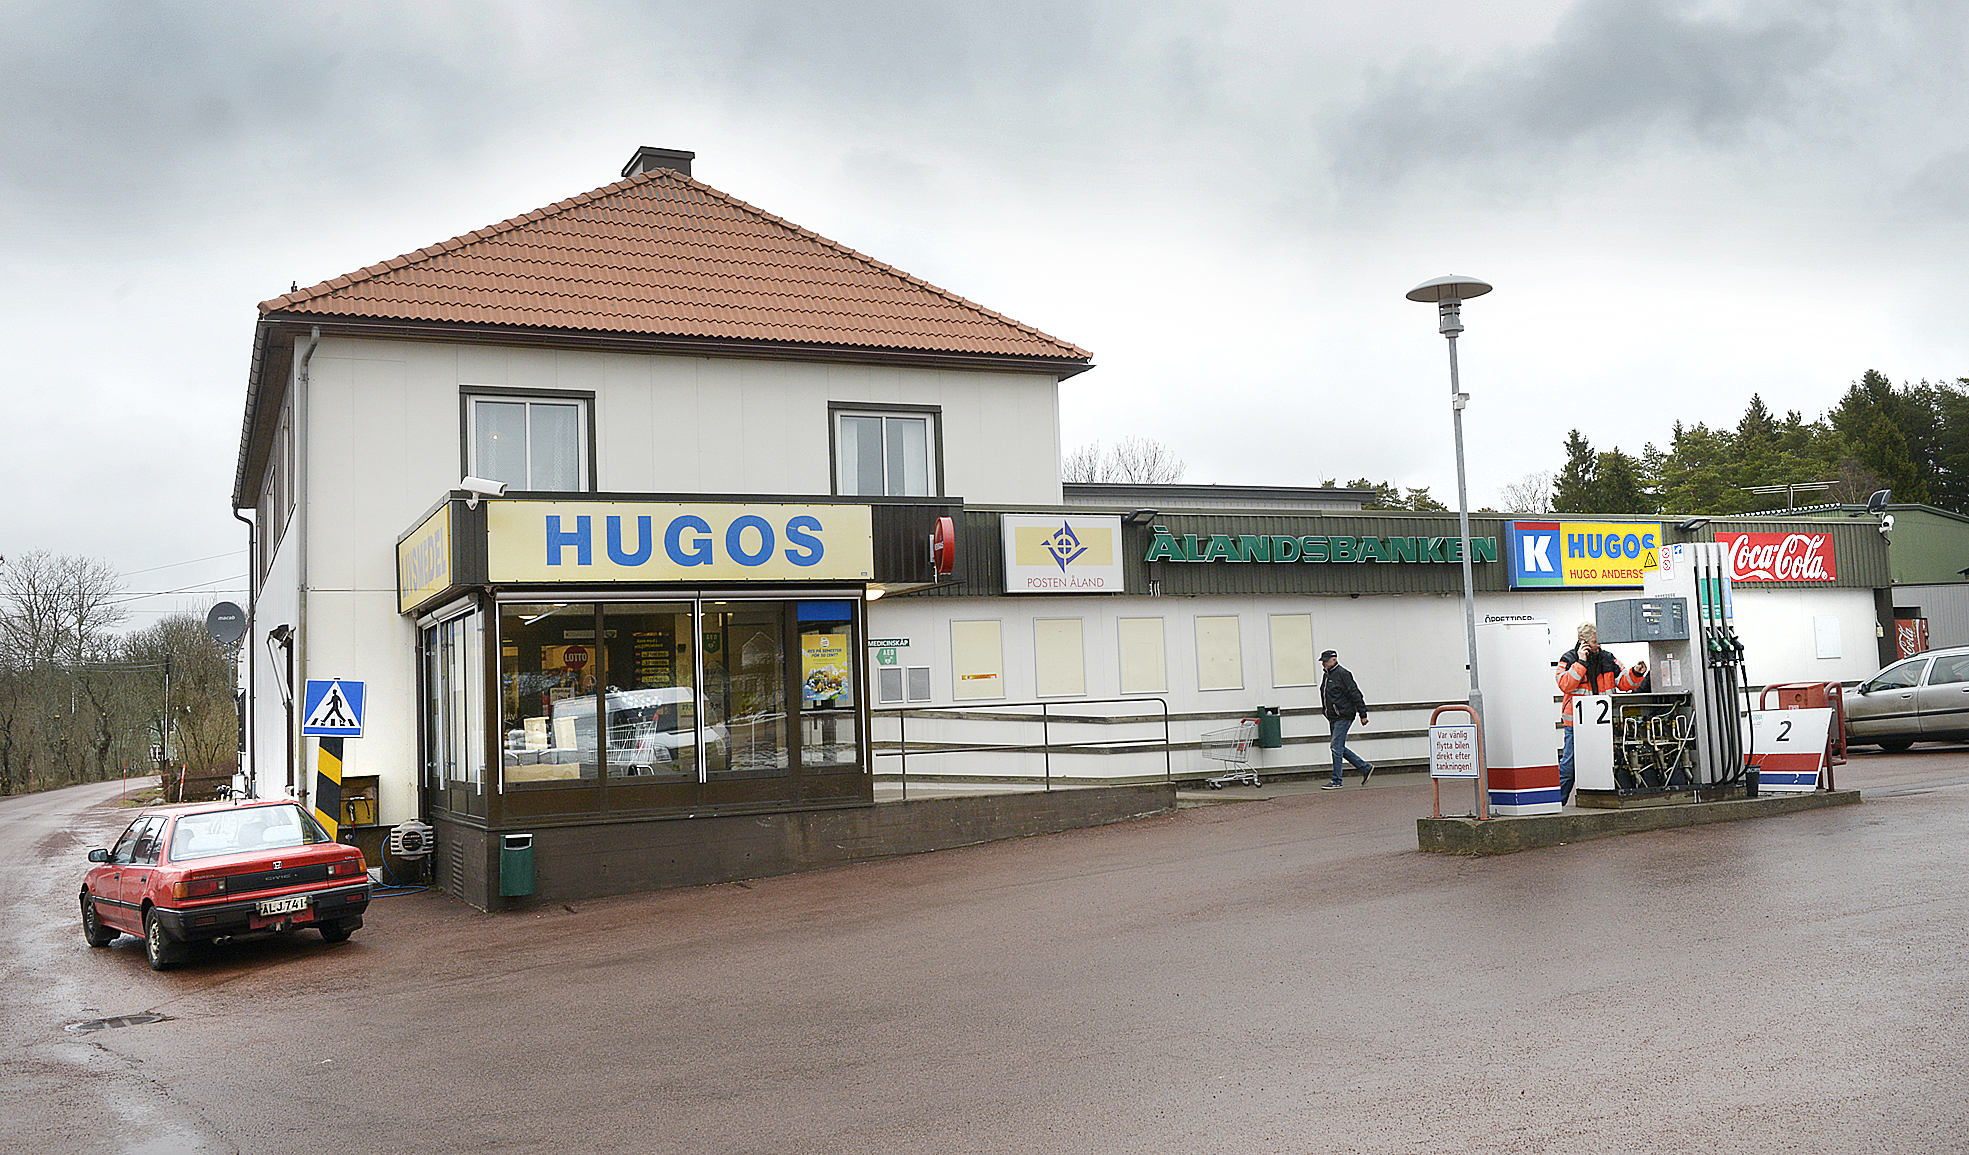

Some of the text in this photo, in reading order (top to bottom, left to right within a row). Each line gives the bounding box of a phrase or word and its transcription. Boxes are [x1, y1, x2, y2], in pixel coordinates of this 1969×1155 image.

[545, 514, 825, 567] HUGOS
[1523, 535, 1554, 572] K
[1728, 533, 1826, 580] Coca-Cola
[401, 526, 446, 598] LIVSMEDEL
[1570, 570, 1598, 579] HUGO
[1027, 575, 1105, 588] POSTEN ÅLAND
[564, 652, 588, 662] LOTTO
[1575, 699, 1610, 724] 1 2
[1449, 730, 1468, 740] vänlig
[1776, 721, 1792, 741] 2
[1436, 741, 1470, 751] flytta bilen
[1436, 752, 1471, 760] direkt efter
[1436, 762, 1472, 772] tankningen!
